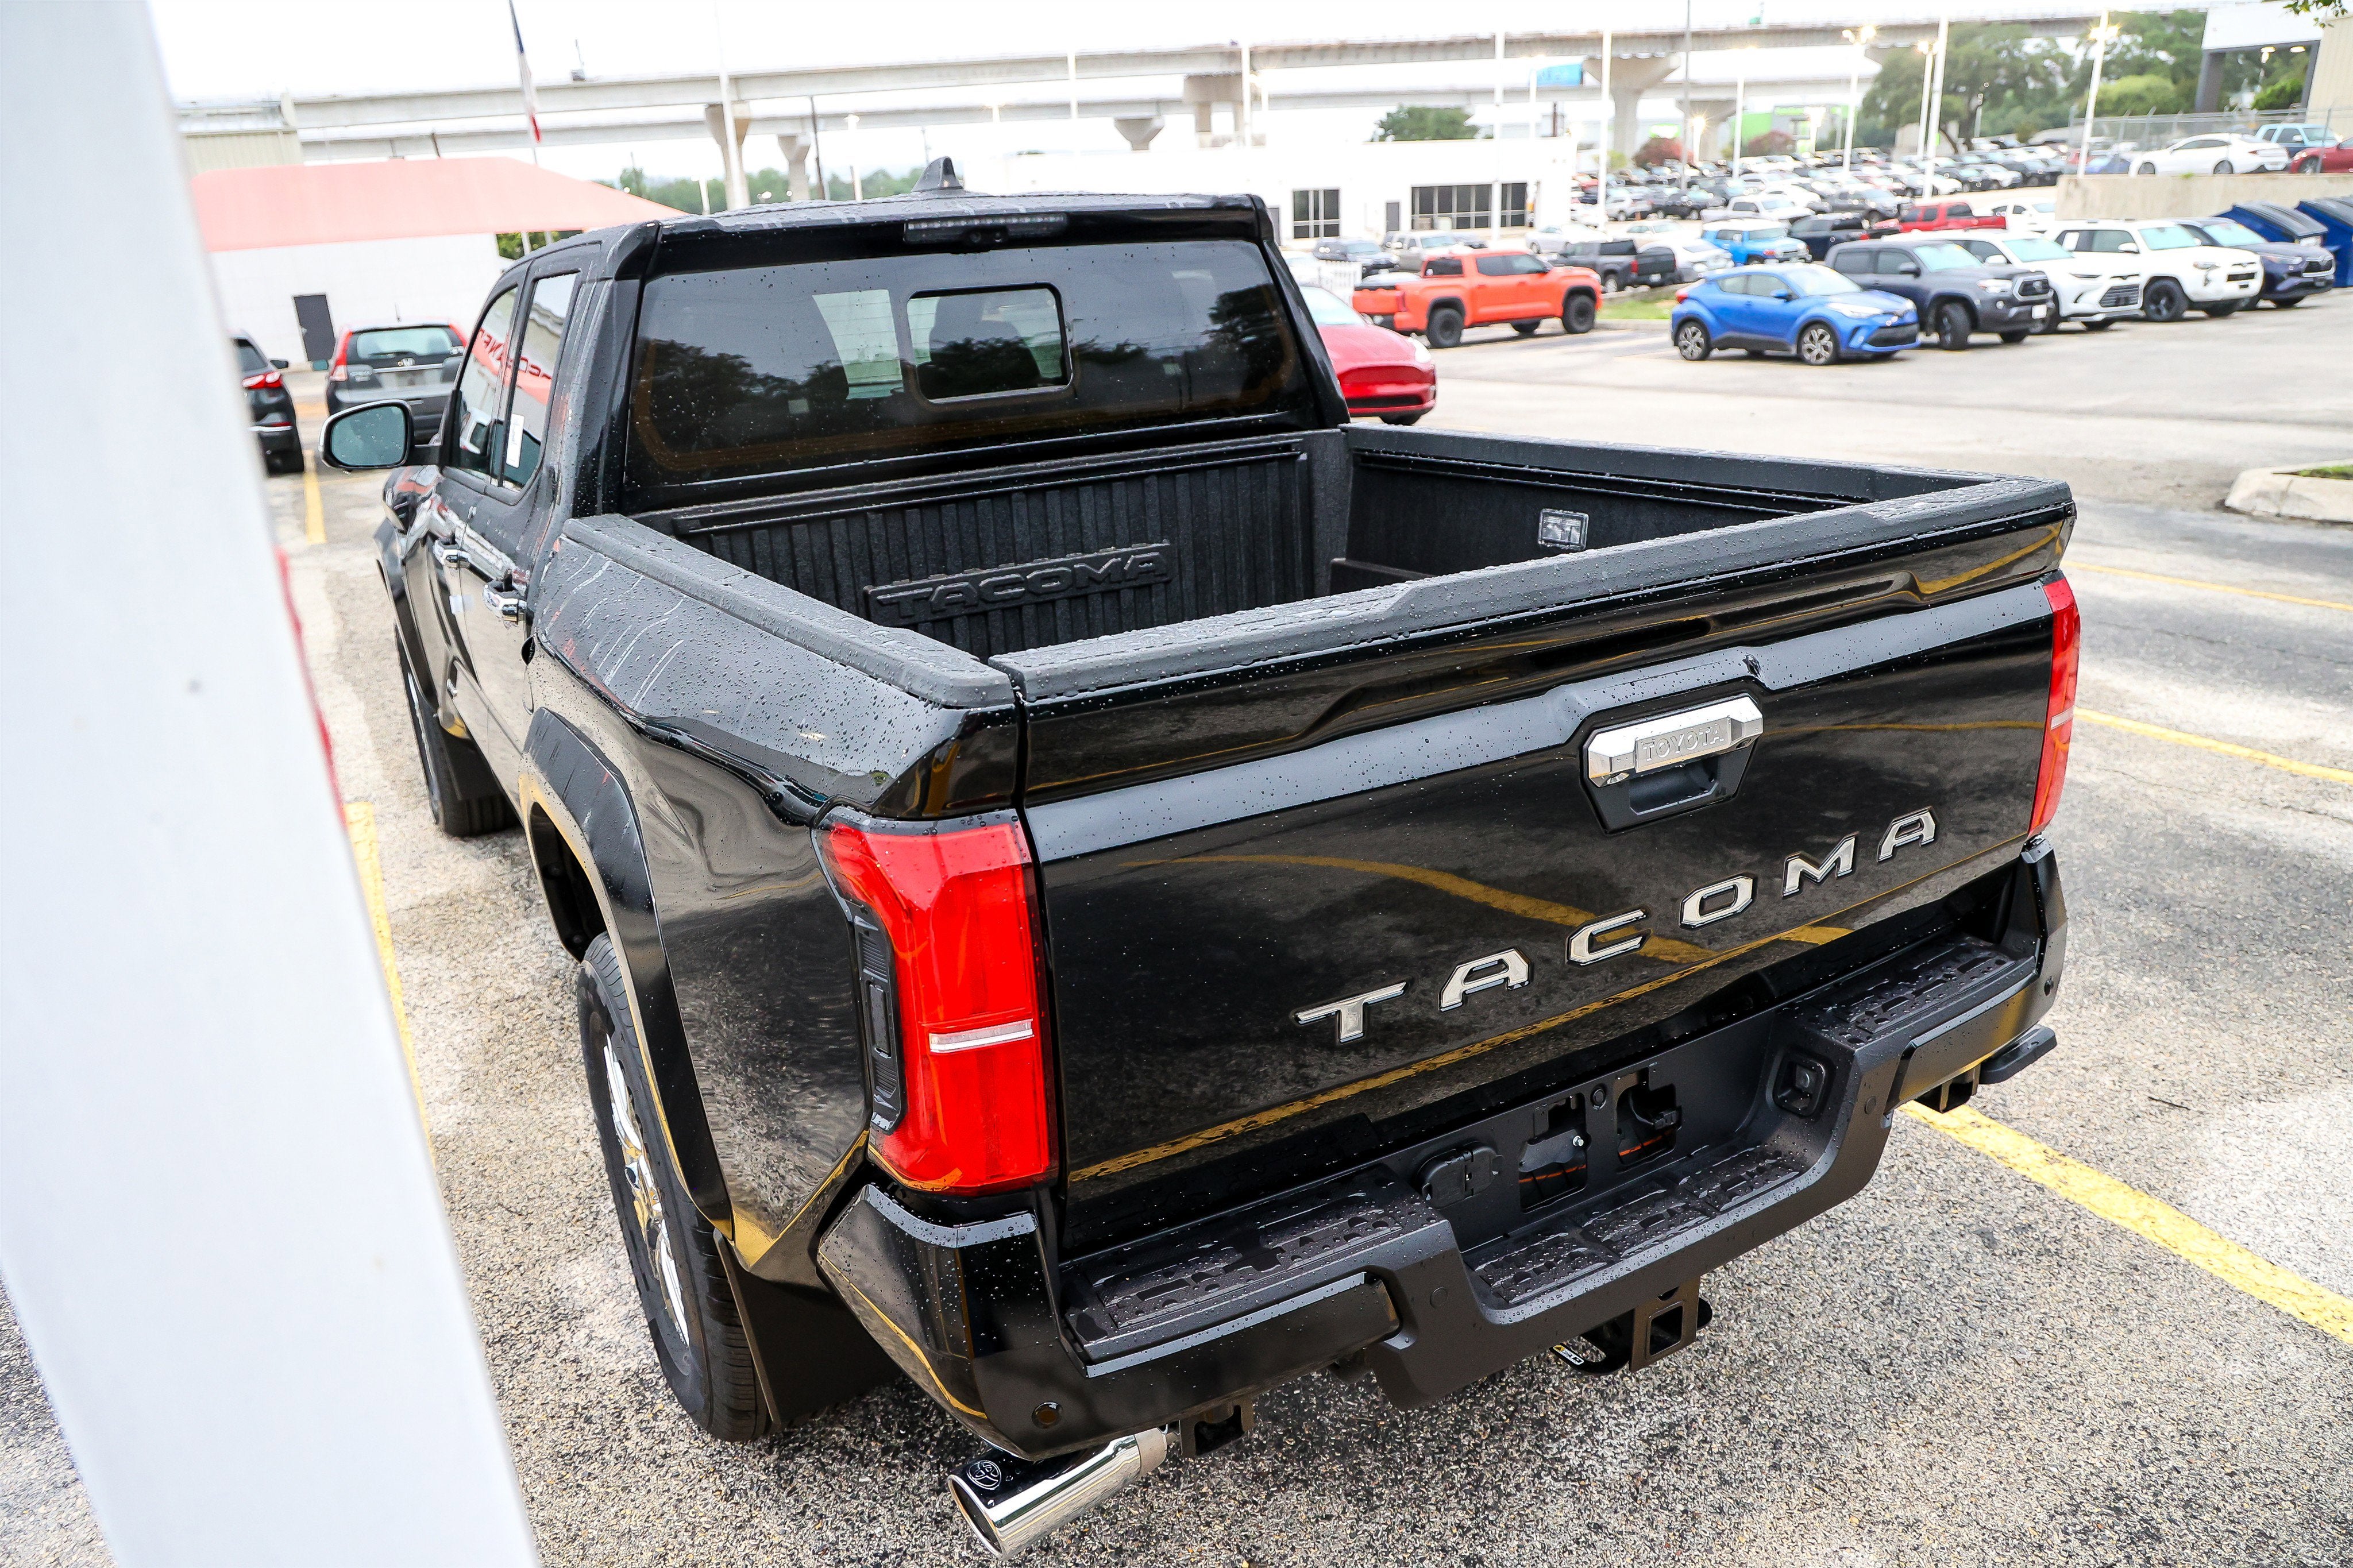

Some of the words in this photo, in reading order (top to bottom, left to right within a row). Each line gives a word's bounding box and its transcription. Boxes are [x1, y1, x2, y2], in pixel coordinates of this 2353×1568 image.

[877, 551, 1168, 619] TACOMA
[1641, 724, 1725, 761] TOYOTA
[1294, 806, 1936, 1042] TACOMA
